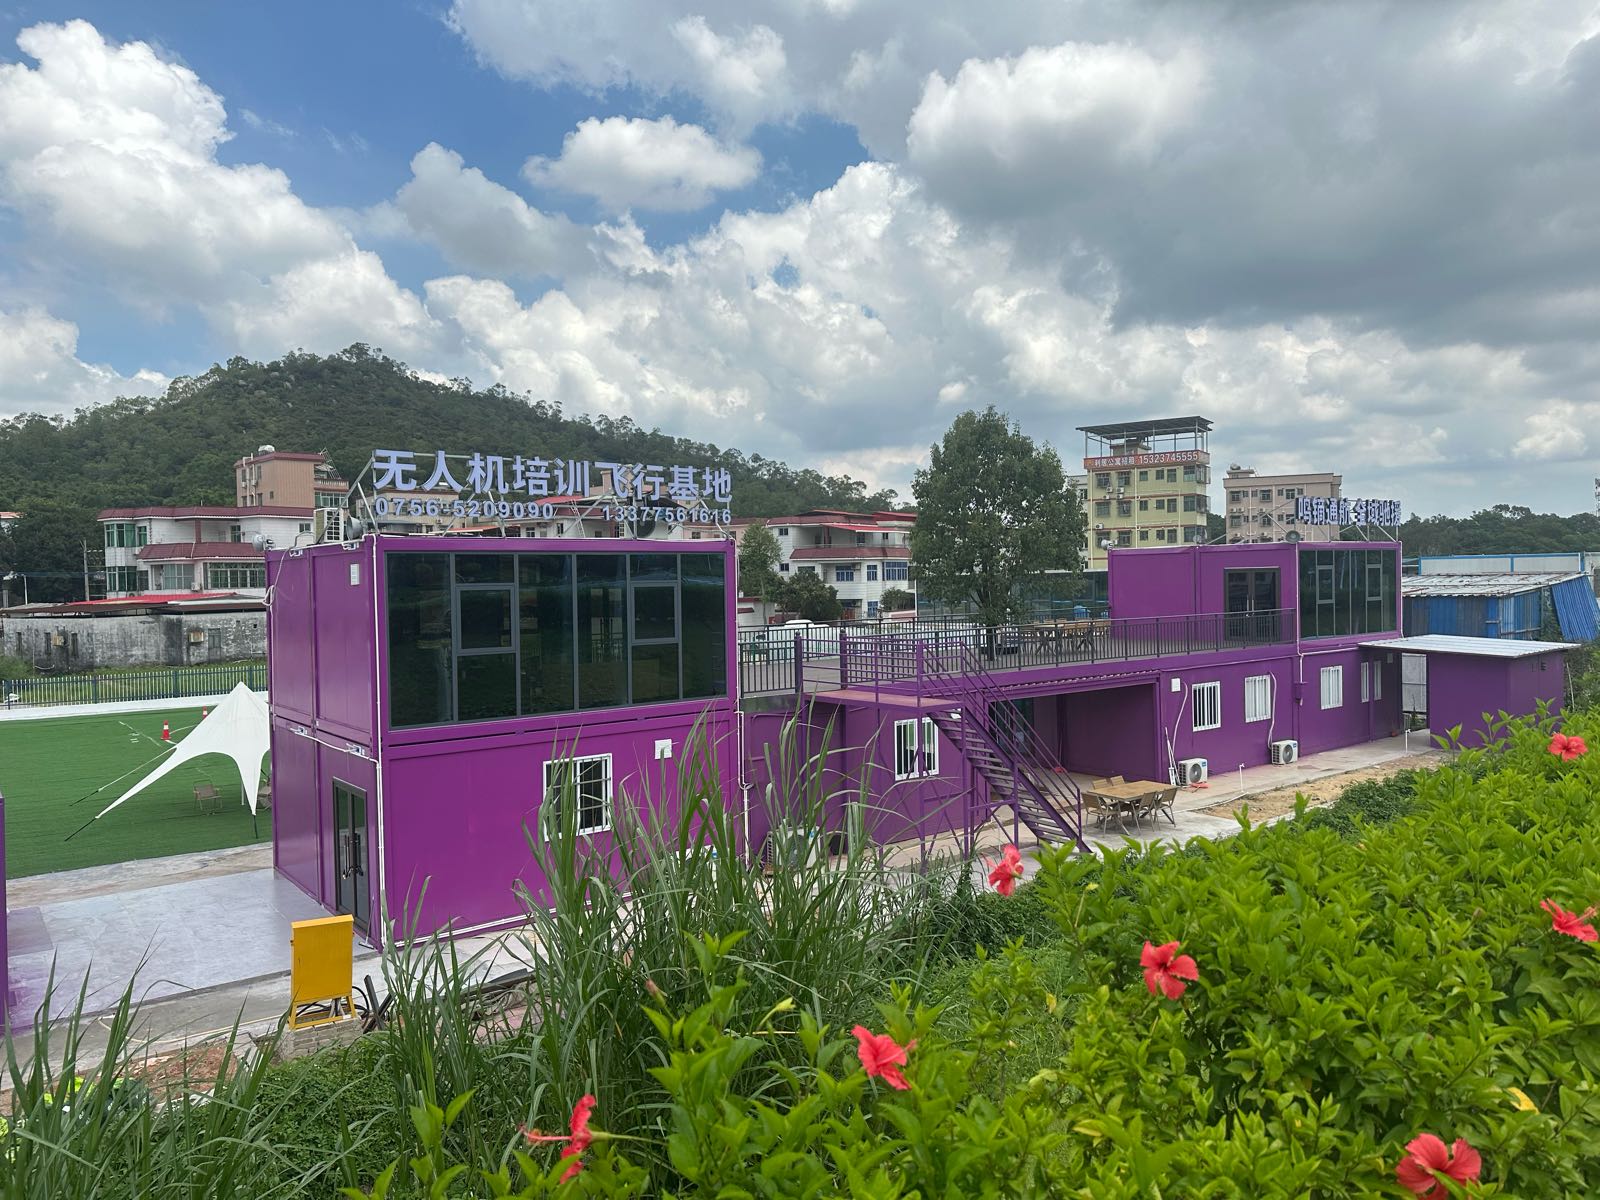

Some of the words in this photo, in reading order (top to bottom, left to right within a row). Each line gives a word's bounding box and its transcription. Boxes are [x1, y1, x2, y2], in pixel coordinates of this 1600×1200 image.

[1139, 451, 1198, 465] 15323745555
[373, 449, 733, 503] 无人机培训飞行基地
[374, 496, 554, 520] 0756-5209090
[602, 505, 732, 525] 13377561616
